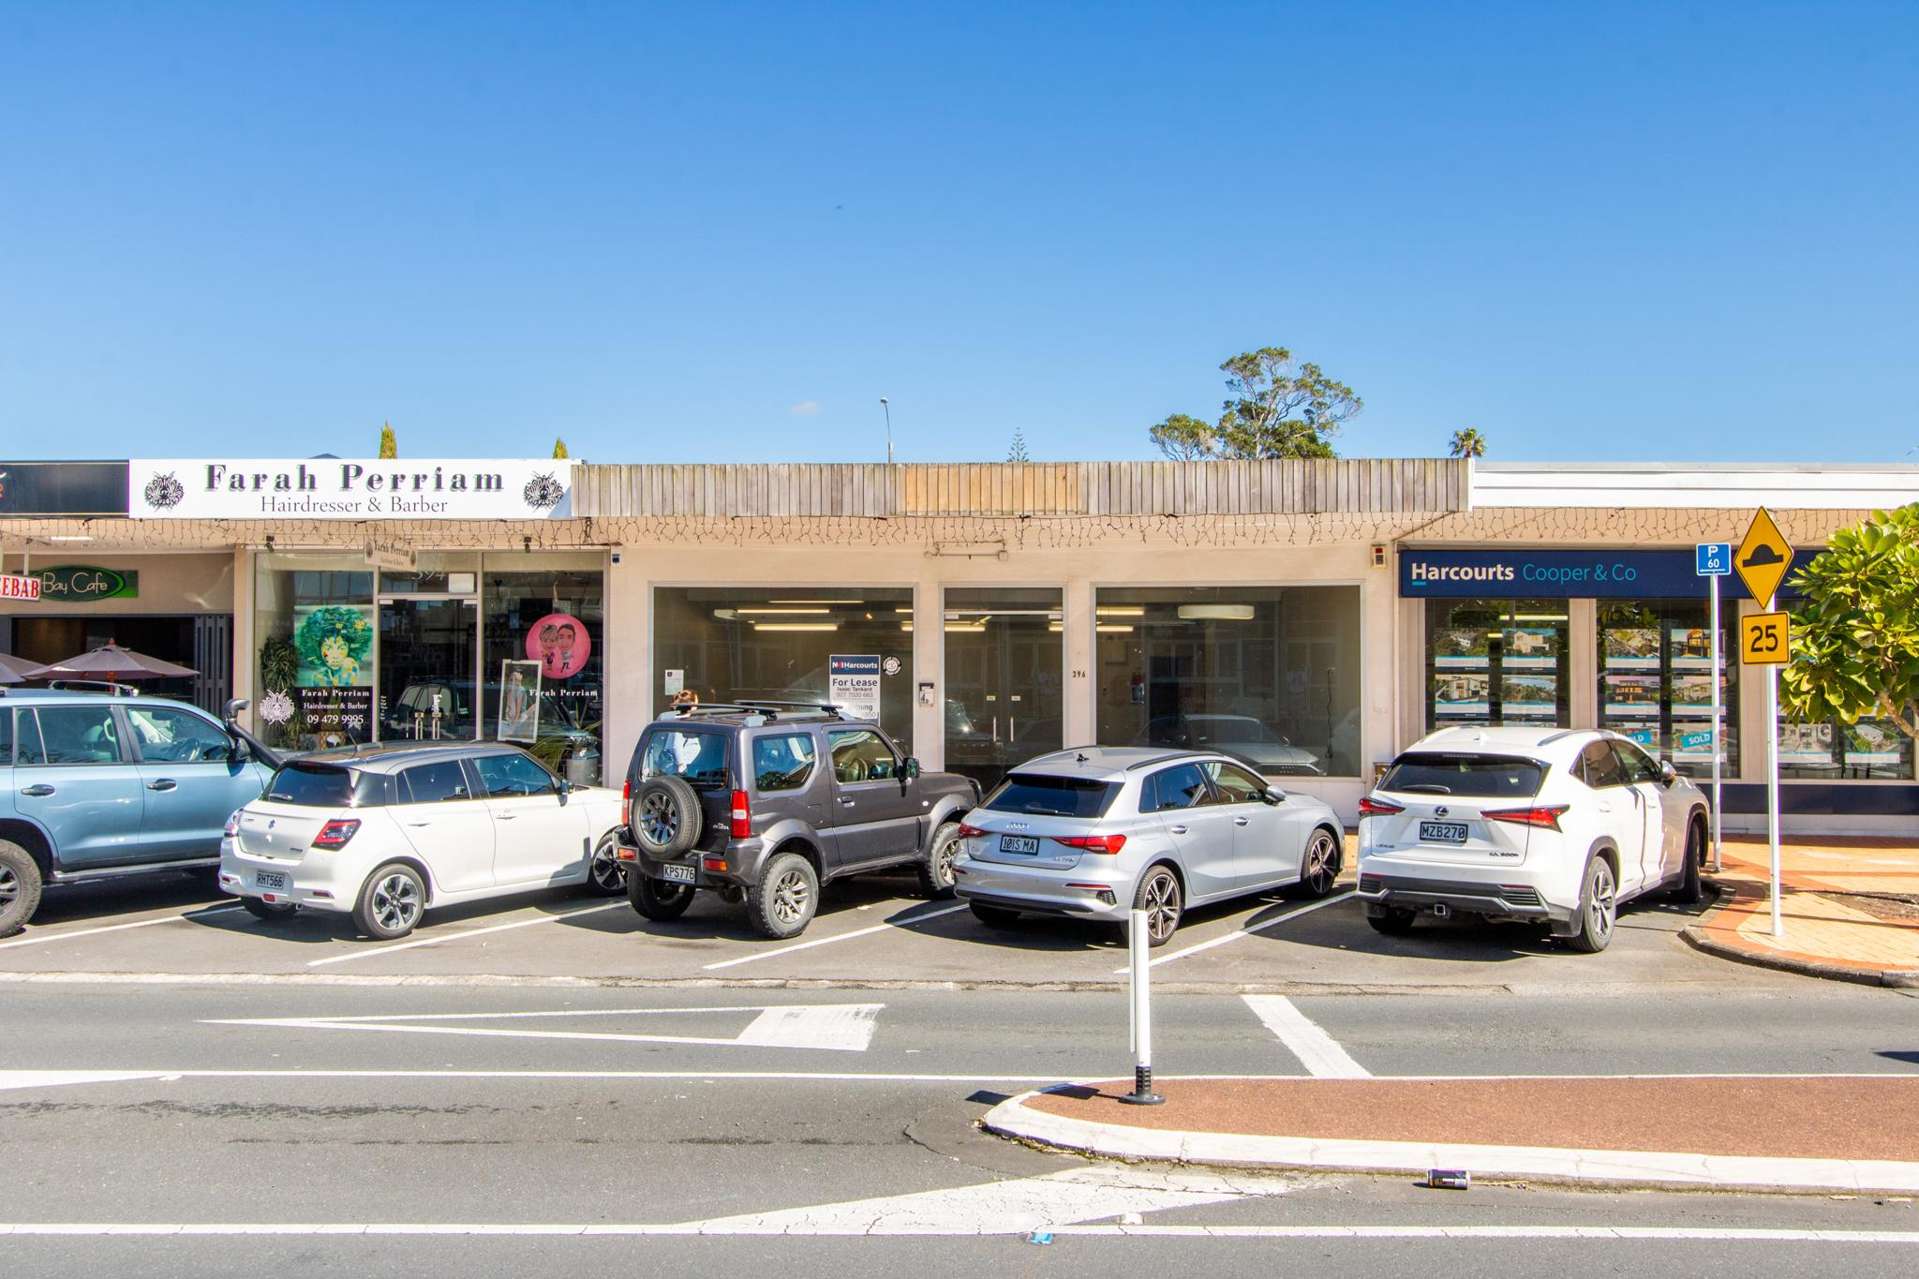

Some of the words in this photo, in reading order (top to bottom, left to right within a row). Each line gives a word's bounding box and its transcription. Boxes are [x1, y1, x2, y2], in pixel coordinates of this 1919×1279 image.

[206, 464, 317, 493] Farah
[340, 463, 504, 493] Perriam
[261, 495, 362, 513] Hairdresser
[367, 496, 382, 513] &
[391, 495, 448, 513] Barber
[1707, 545, 1719, 558] P
[1707, 558, 1720, 568] 60
[1411, 562, 1515, 581] Harcourts
[1522, 563, 1591, 584] Cooper
[1593, 563, 1607, 582] &
[1612, 563, 1637, 582] Co
[0, 575, 40, 598] EBAB
[42, 571, 68, 594] Bay
[71, 571, 108, 594] Cafe
[1750, 624, 1779, 653] 25
[845, 661, 878, 669] Harcourts
[832, 678, 848, 687] For
[850, 678, 878, 687] Lease
[528, 688, 556, 697] Farah
[560, 688, 598, 697] Perriam
[303, 702, 339, 710] Hairdresser
[347, 702, 368, 710] Barber
[307, 714, 319, 723] 09
[321, 714, 339, 723] 479
[341, 714, 364, 724] 9995
[1688, 733, 1711, 745] SOLD
[1421, 825, 1466, 839] MZB270
[664, 864, 695, 880] KPS776
